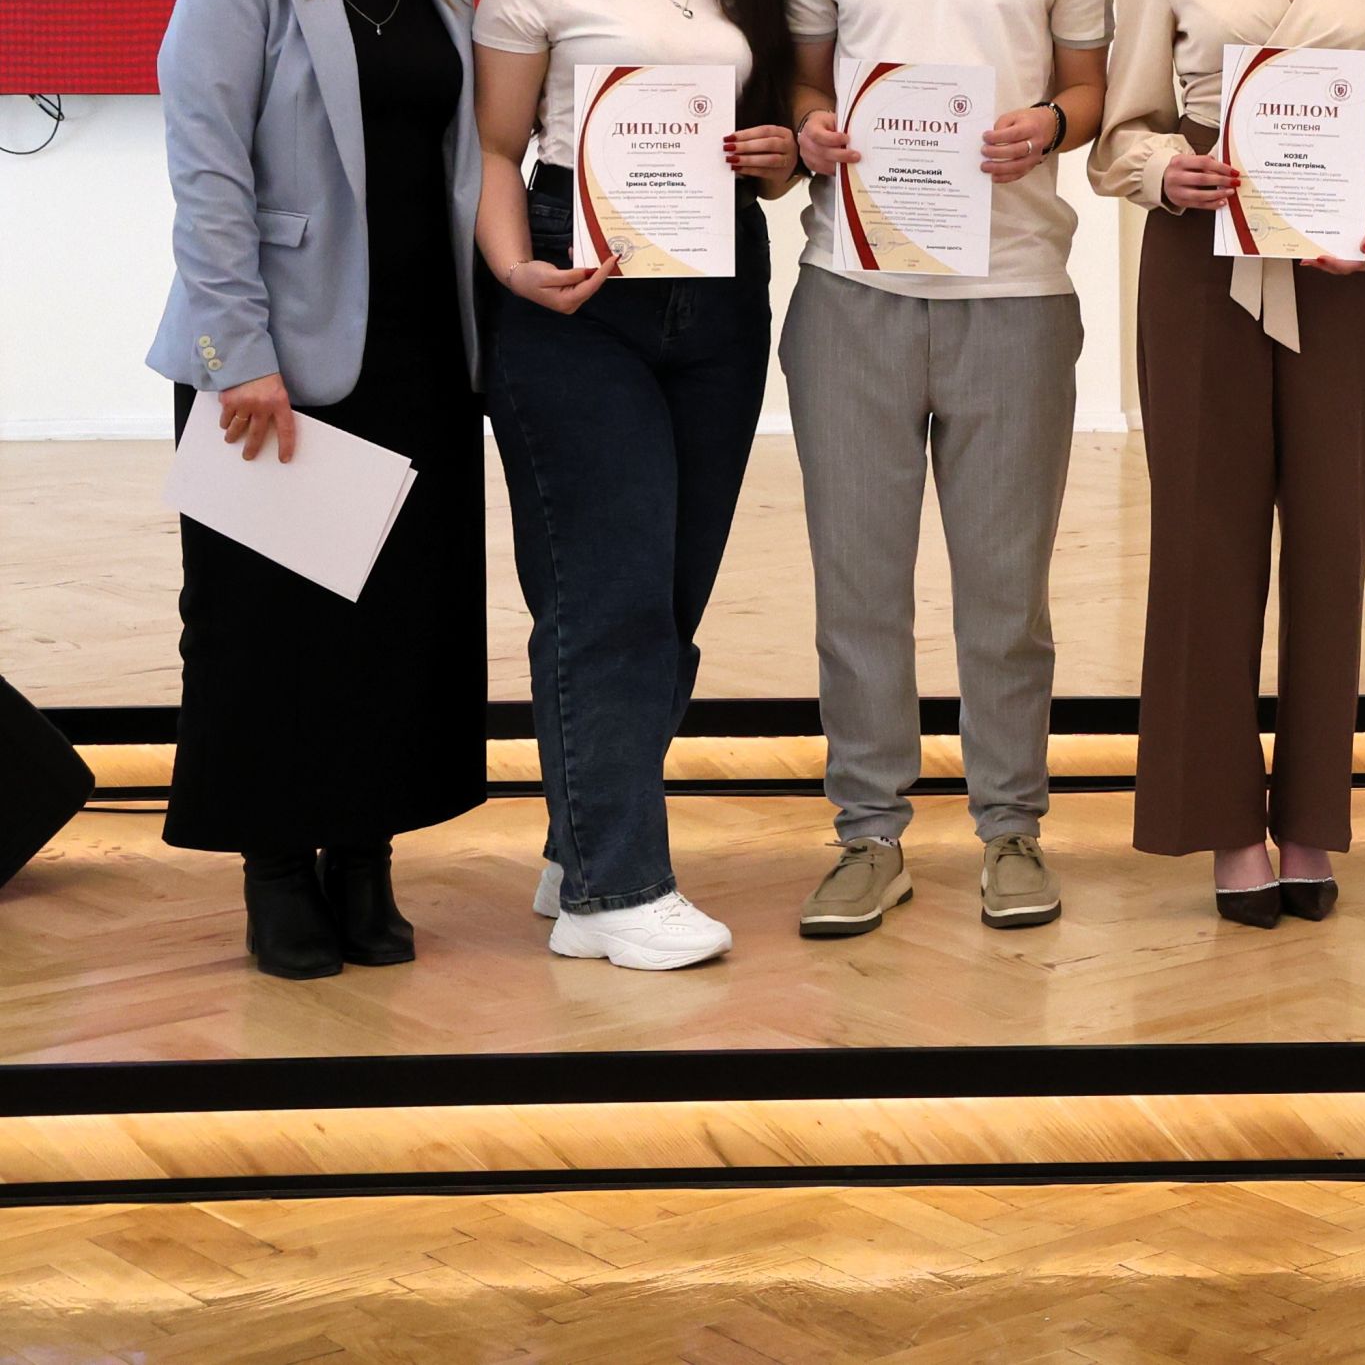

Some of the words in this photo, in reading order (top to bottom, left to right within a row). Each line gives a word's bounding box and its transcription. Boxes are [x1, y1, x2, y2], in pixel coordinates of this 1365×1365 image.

[1256, 103, 1339, 118] ДИПЛОМ
[612, 122, 699, 137] ДИПЛОМ
[874, 117, 959, 134] ДИПЛОМ
[1281, 123, 1320, 131] СТУПЕНЯ
[898, 139, 939, 147] СТУПЕНЯ
[889, 167, 942, 176] ПОЖАРСЬКИЙ
